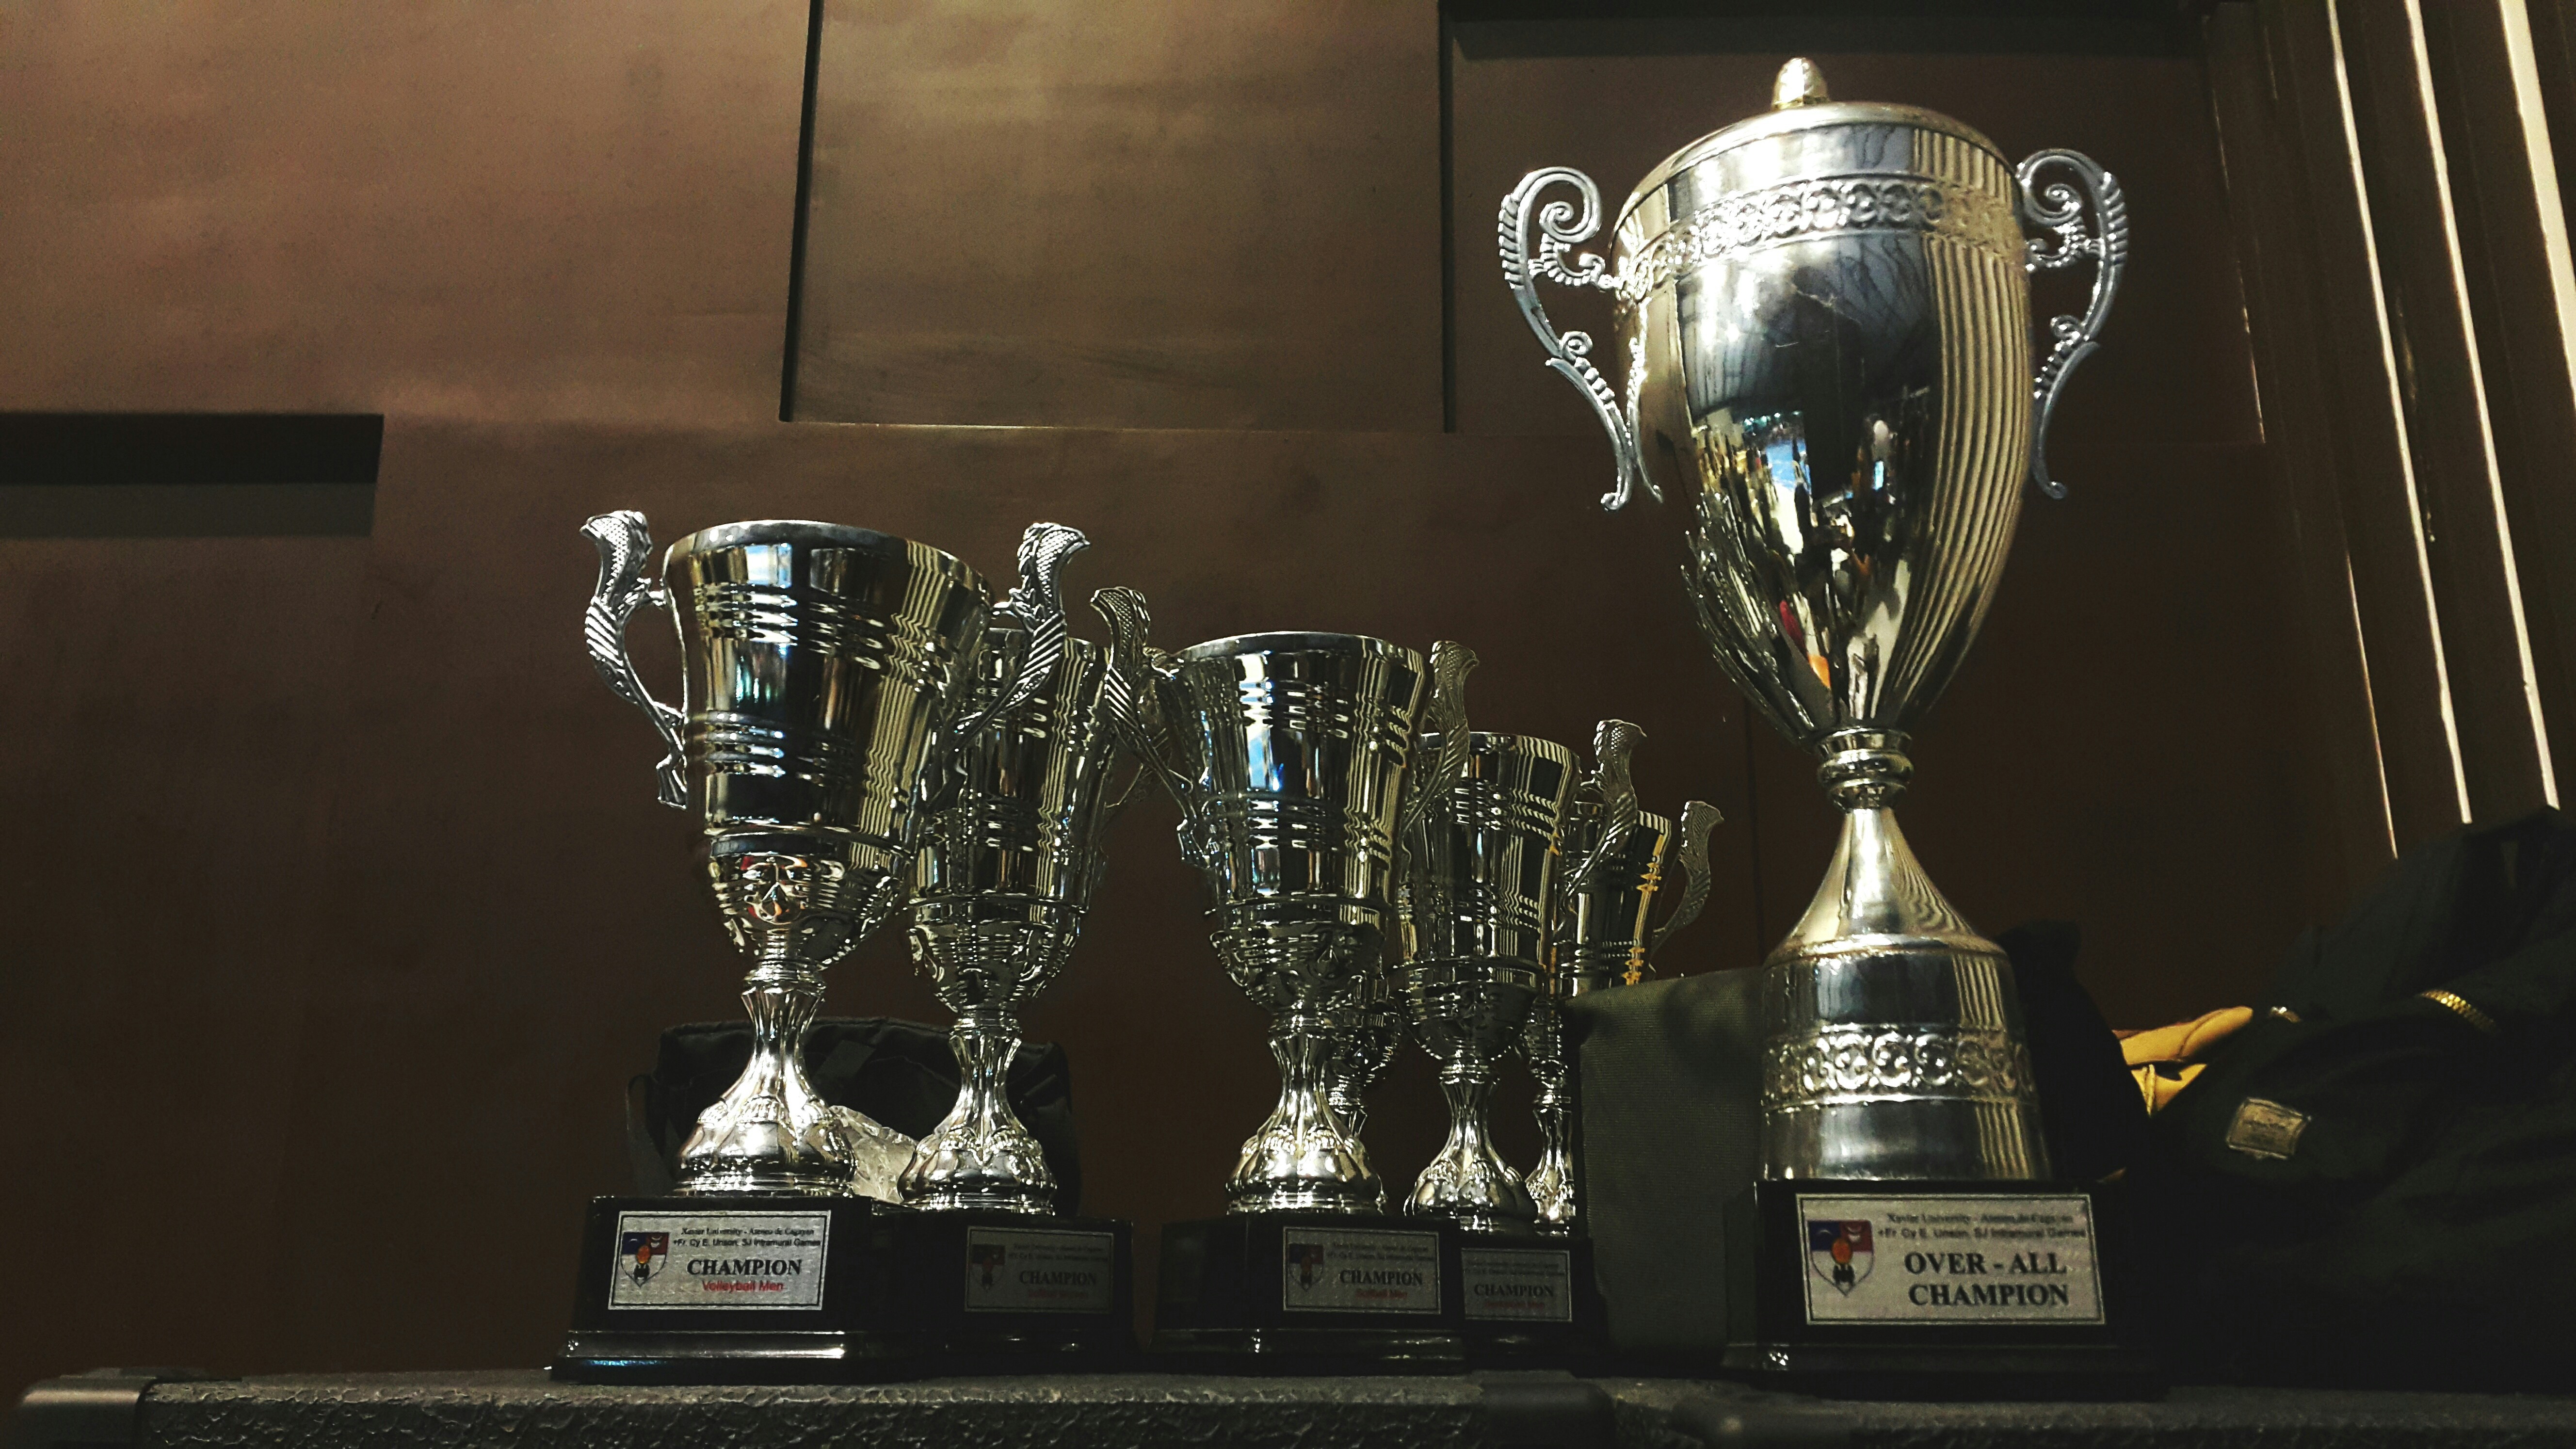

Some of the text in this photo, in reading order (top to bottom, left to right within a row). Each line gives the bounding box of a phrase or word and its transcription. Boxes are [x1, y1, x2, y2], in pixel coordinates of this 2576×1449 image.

[707, 1227, 742, 1237] University
[690, 1239, 700, 1247] Cy
[754, 1238, 791, 1246] Intramural
[793, 1238, 821, 1246] Games
[687, 1259, 802, 1275] CHAMPION
[1904, 1252, 1986, 1274] OVER
[2010, 1251, 2067, 1274] ALL
[1019, 1270, 1096, 1286] CHAMPION
[1339, 1270, 1423, 1286] CHAMPION
[702, 1280, 785, 1293] Volleyball Men
[1474, 1284, 1554, 1297] CHAMPION
[1908, 1283, 2069, 1305] CHAMPION
